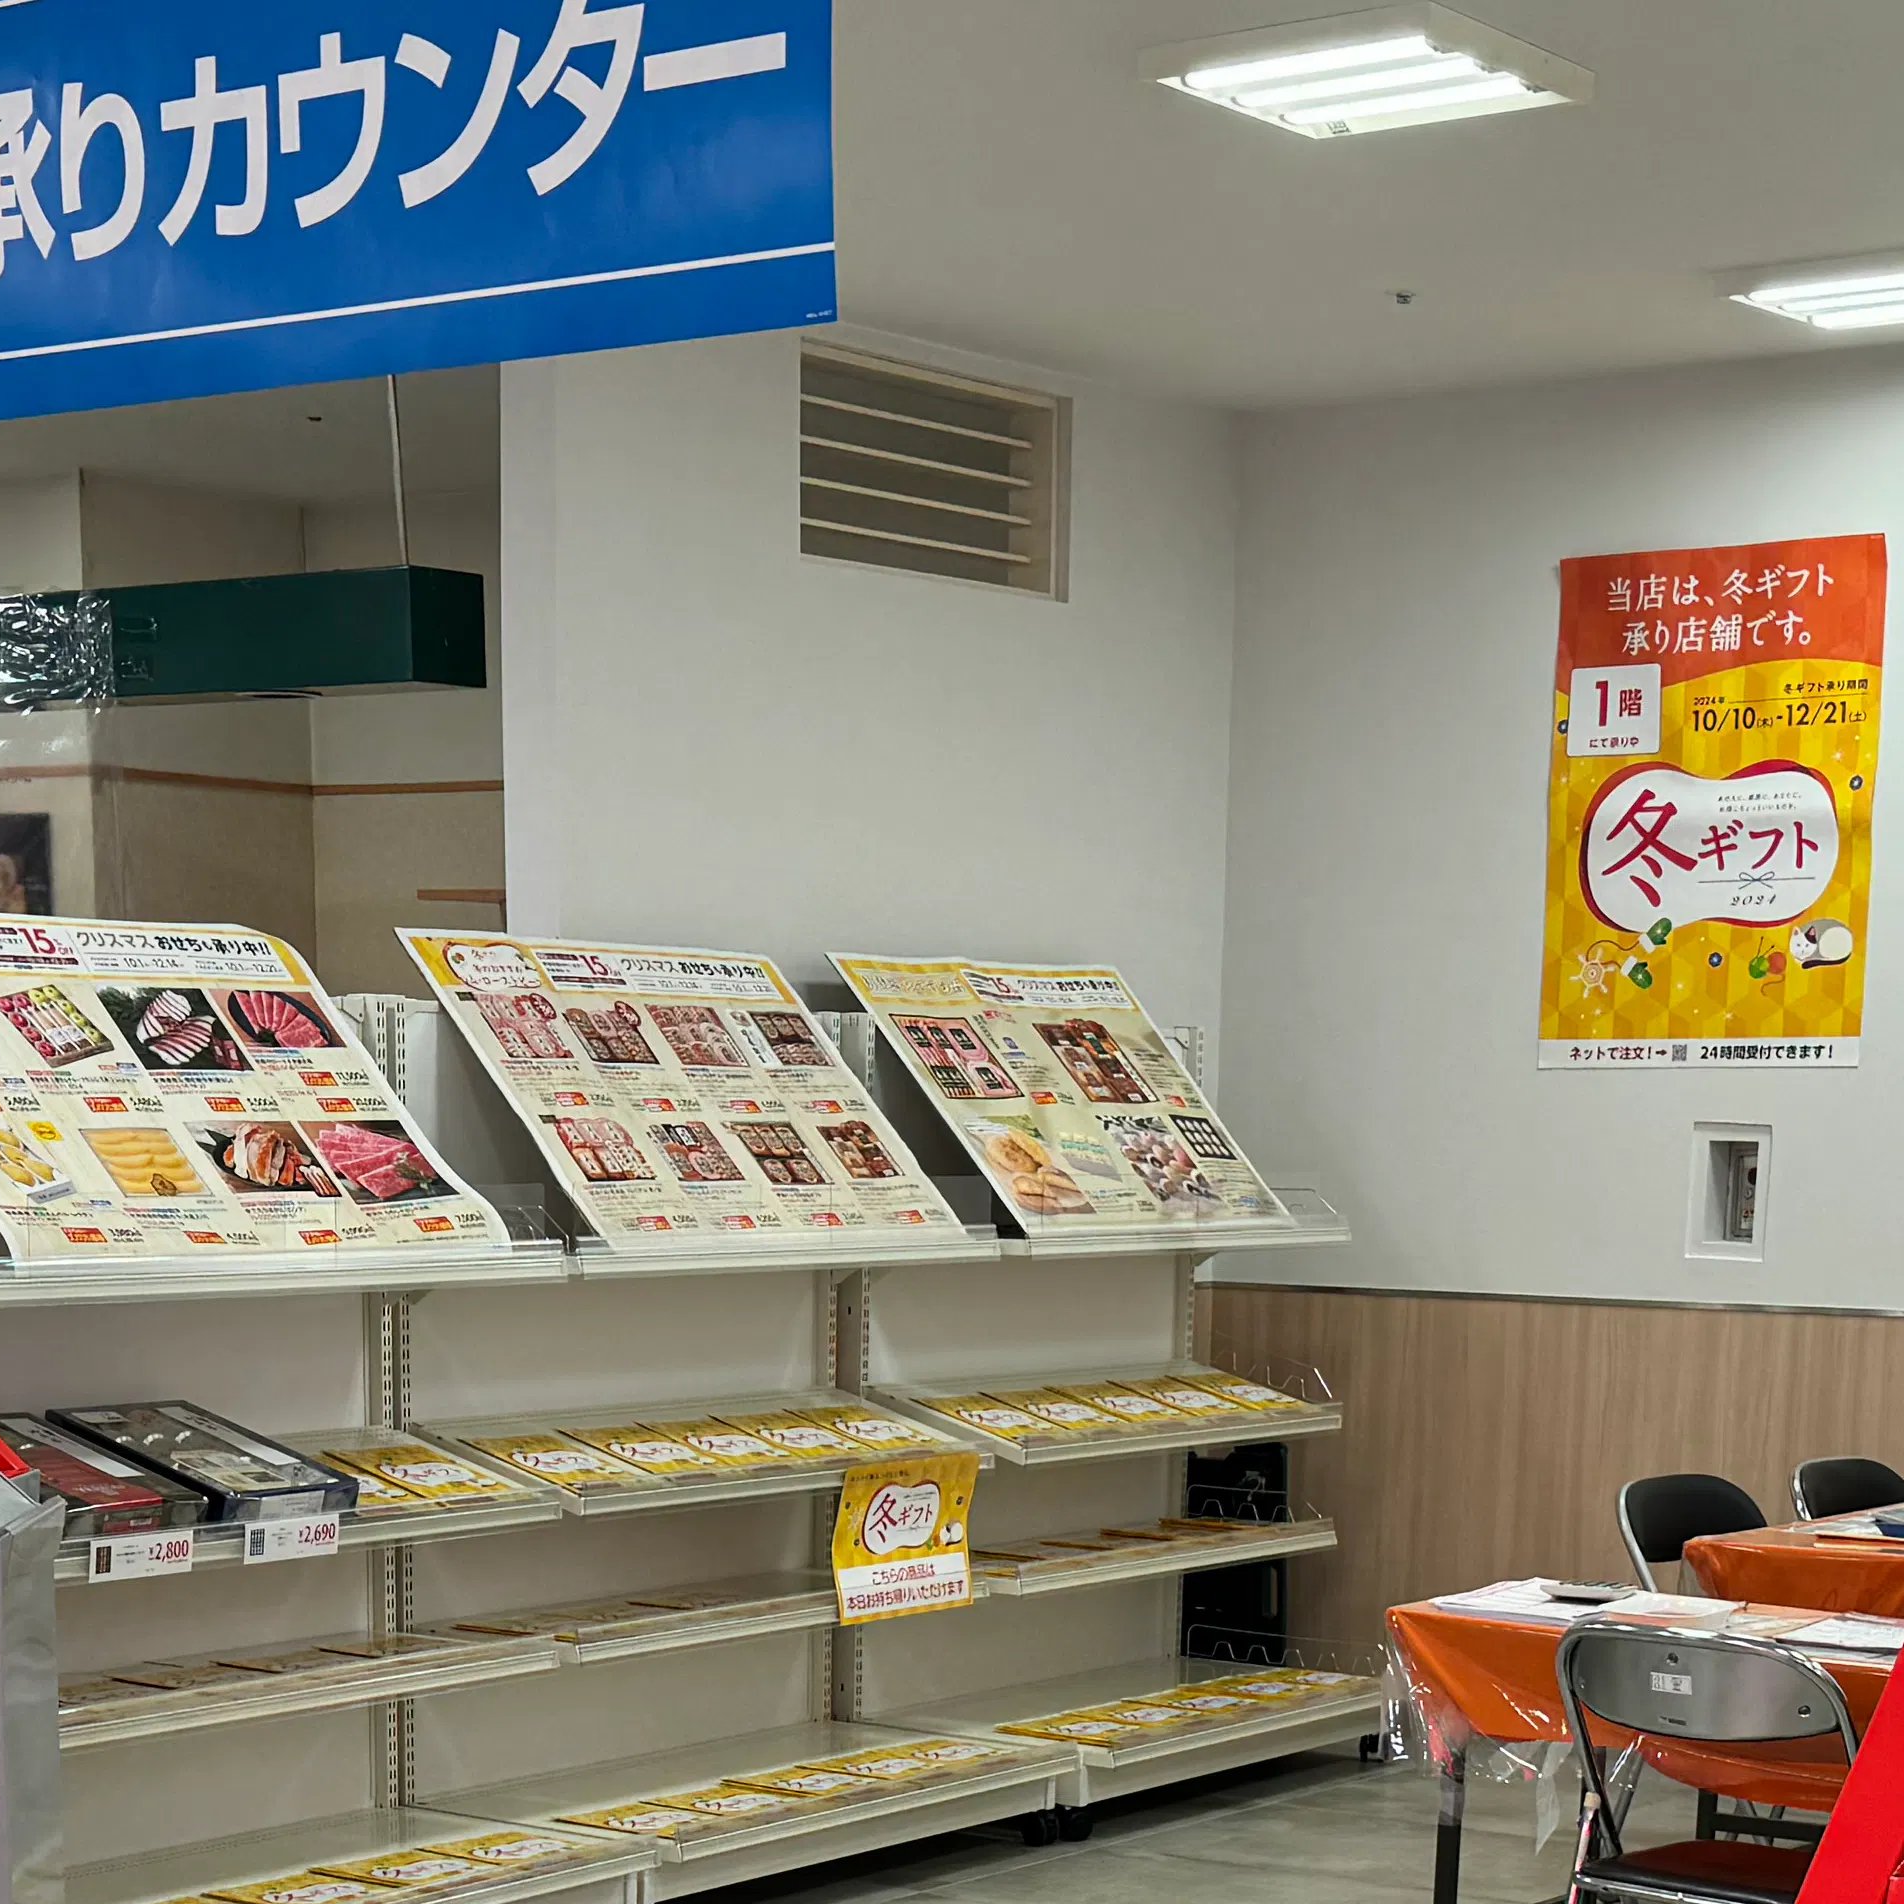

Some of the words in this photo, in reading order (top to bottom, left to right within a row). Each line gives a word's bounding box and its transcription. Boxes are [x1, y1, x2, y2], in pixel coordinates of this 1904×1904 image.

[1607, 562, 1836, 613] 当店は、冬ギフト
[1621, 612, 1813, 657] 承り店舗です。
[1595, 680, 1643, 727] 1階
[1601, 788, 1819, 908] 冬ギフト
[76, 931, 154, 951] クリスマス
[868, 1492, 933, 1544] 冬ギフト
